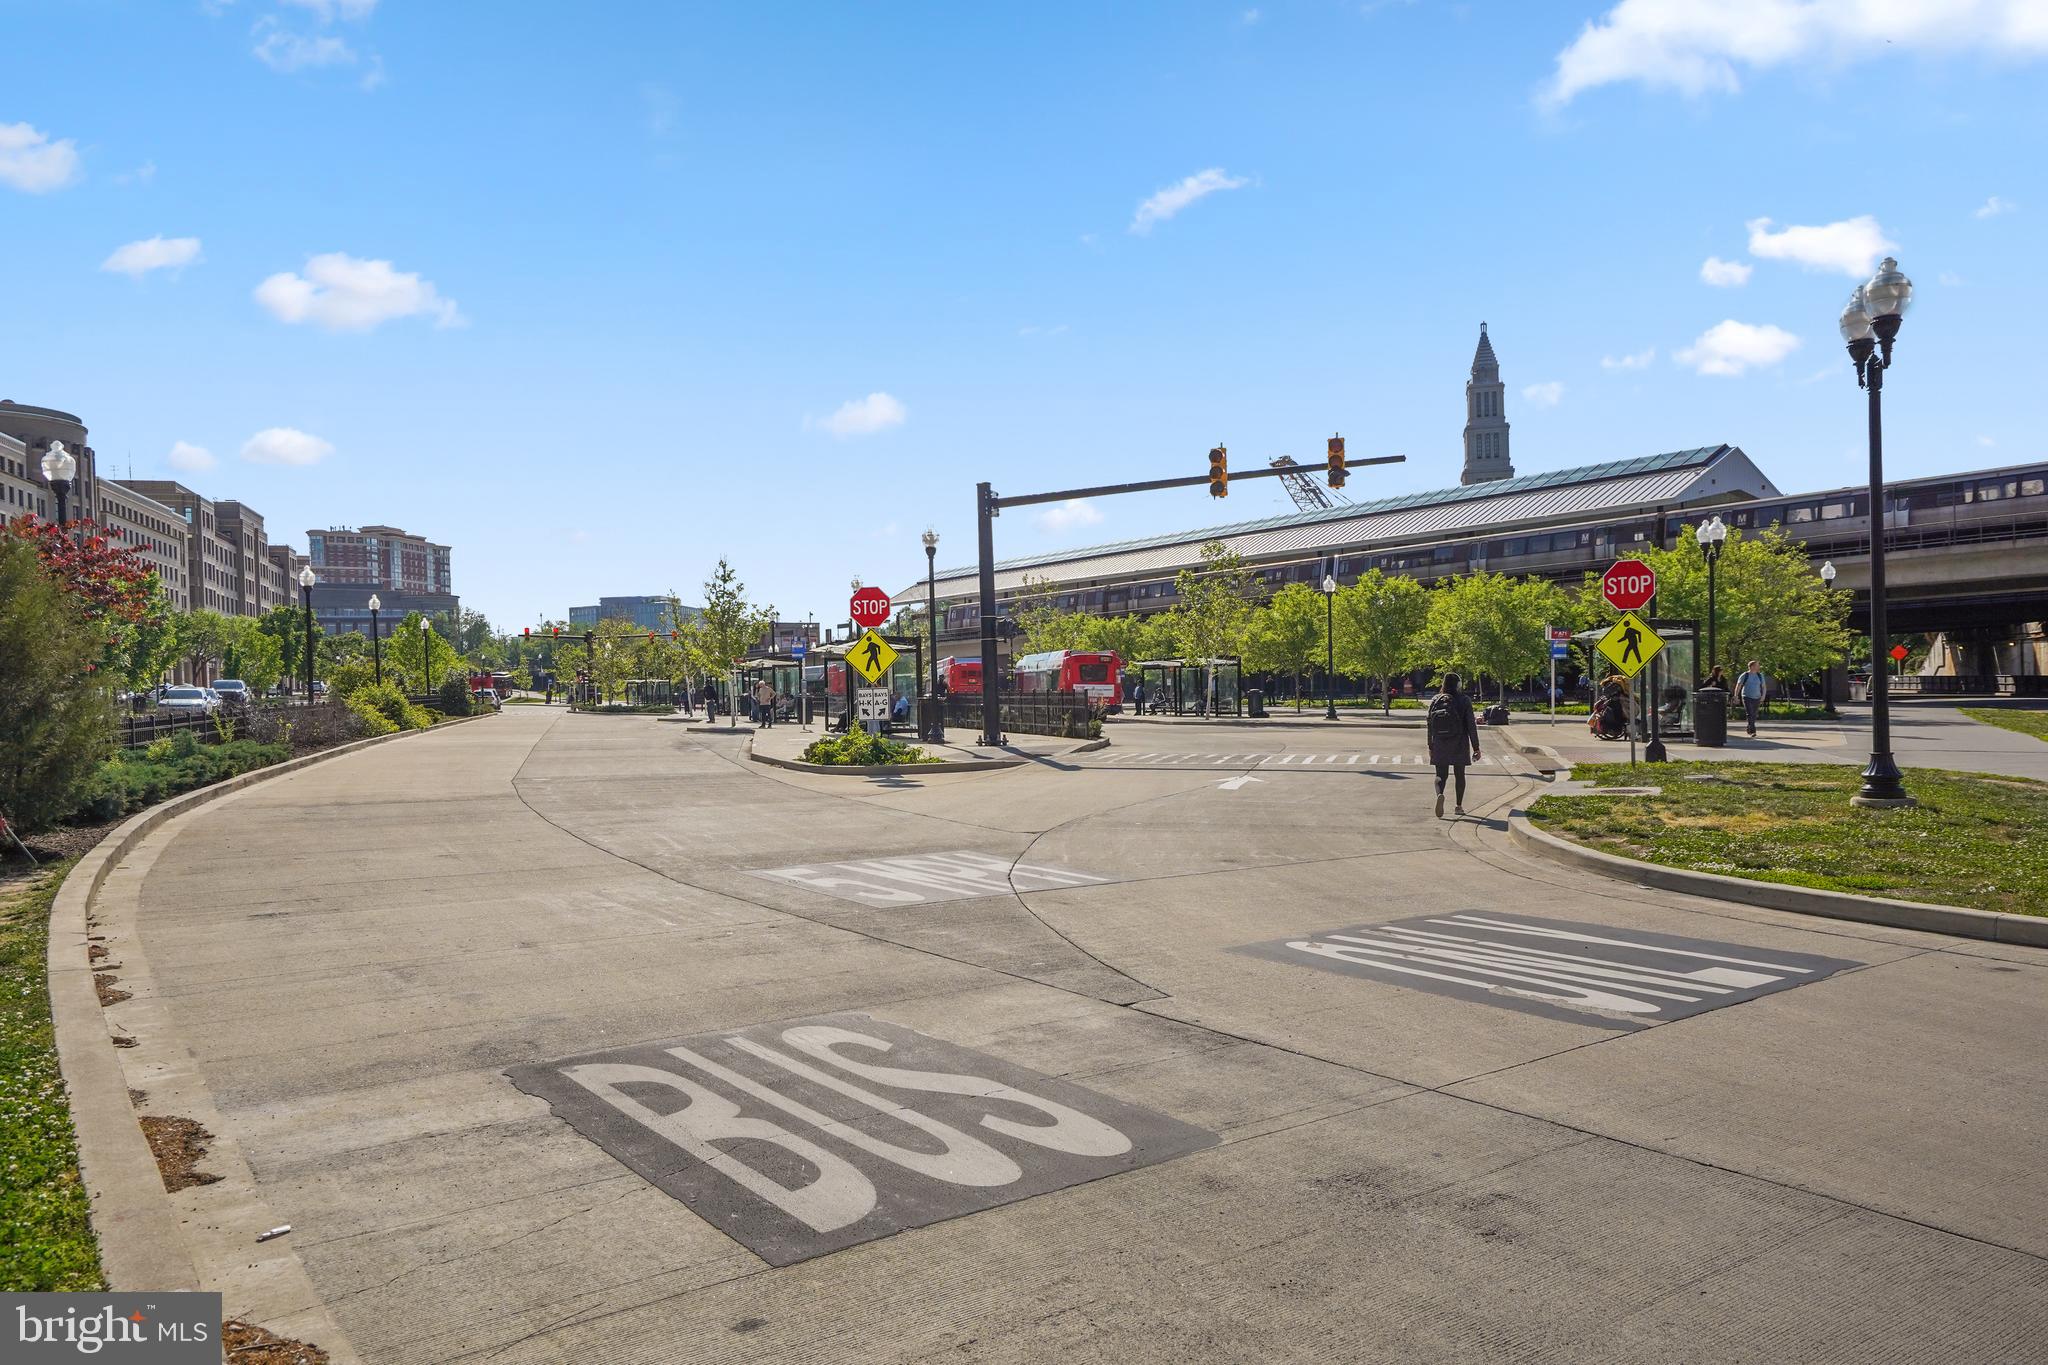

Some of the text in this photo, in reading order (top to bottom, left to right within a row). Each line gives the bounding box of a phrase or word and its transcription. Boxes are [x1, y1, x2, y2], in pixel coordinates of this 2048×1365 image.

[1606, 575, 1651, 595] STOP
[853, 599, 888, 615] STOP
[875, 698, 887, 706] A-G
[1286, 914, 1815, 1013] ONLY
[560, 1024, 1133, 1234] BUS
